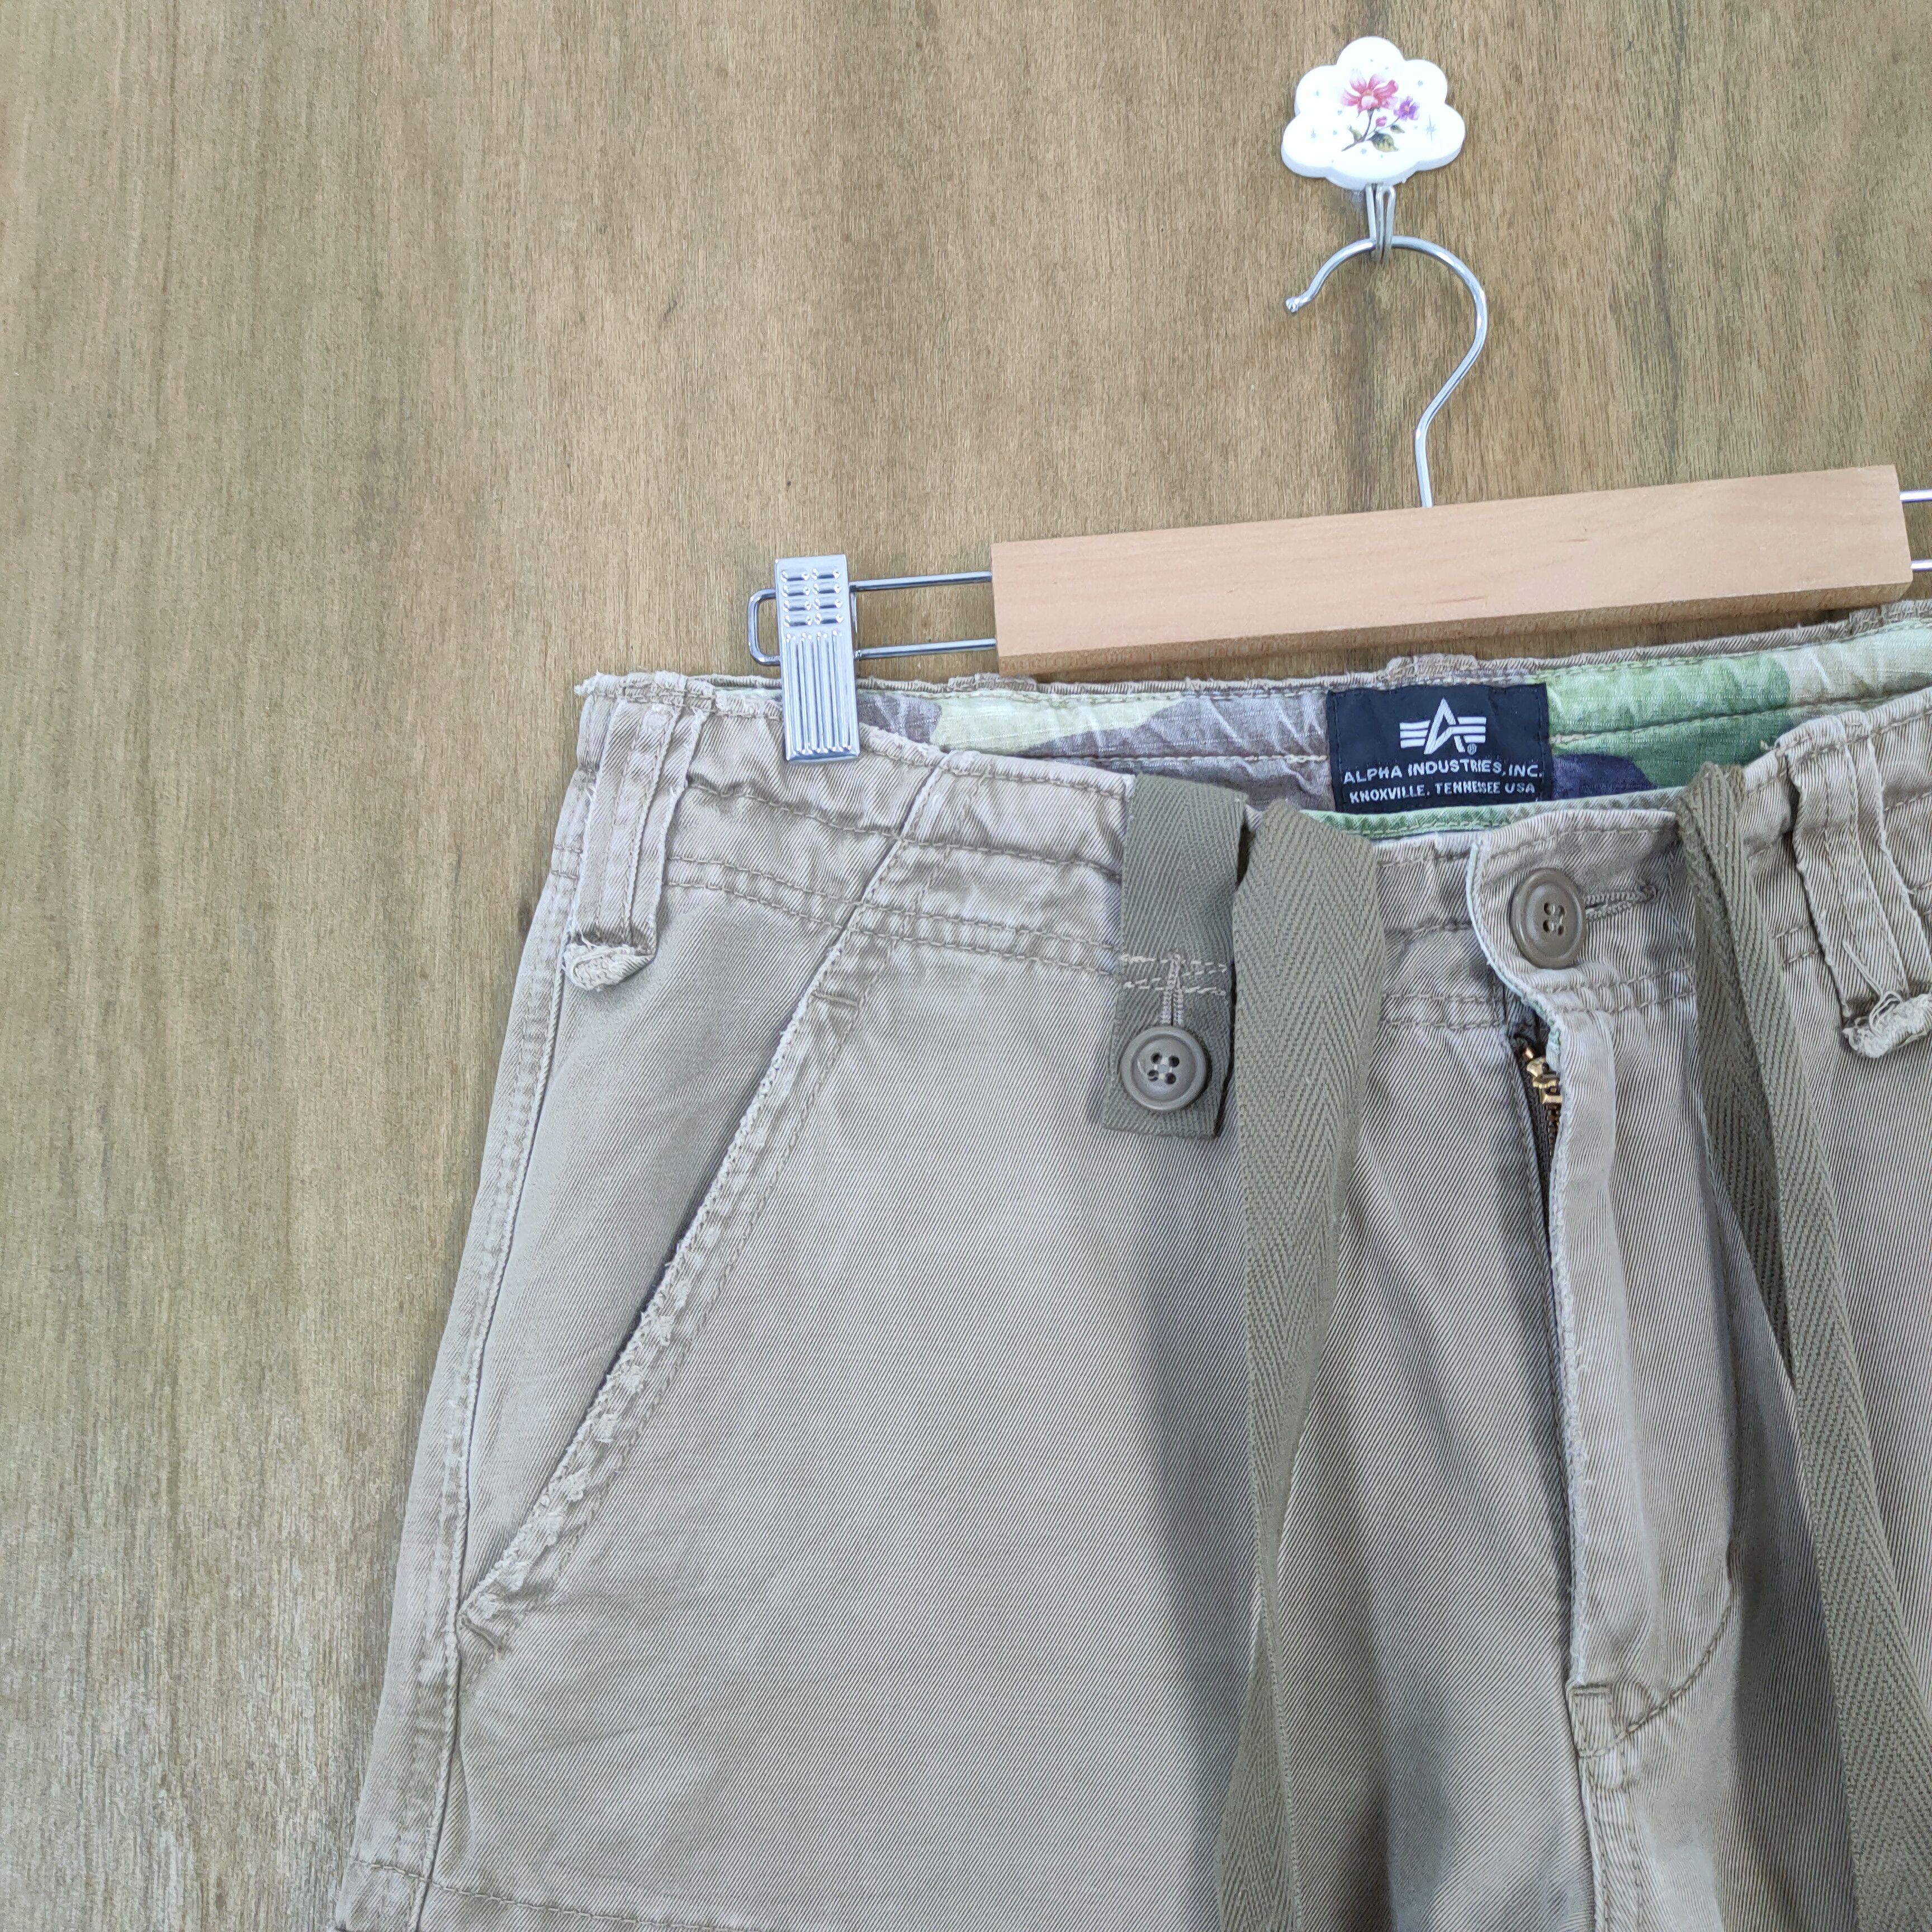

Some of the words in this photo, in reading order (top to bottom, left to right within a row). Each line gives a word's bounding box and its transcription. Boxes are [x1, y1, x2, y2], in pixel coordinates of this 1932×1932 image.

[1343, 765, 1403, 784] ALPHA
[1408, 758, 1506, 777] INDUSTRIES,
[1509, 764, 1542, 778] INC.
[1434, 780, 1500, 795] TENNESSEE
[1505, 782, 1535, 794] USA
